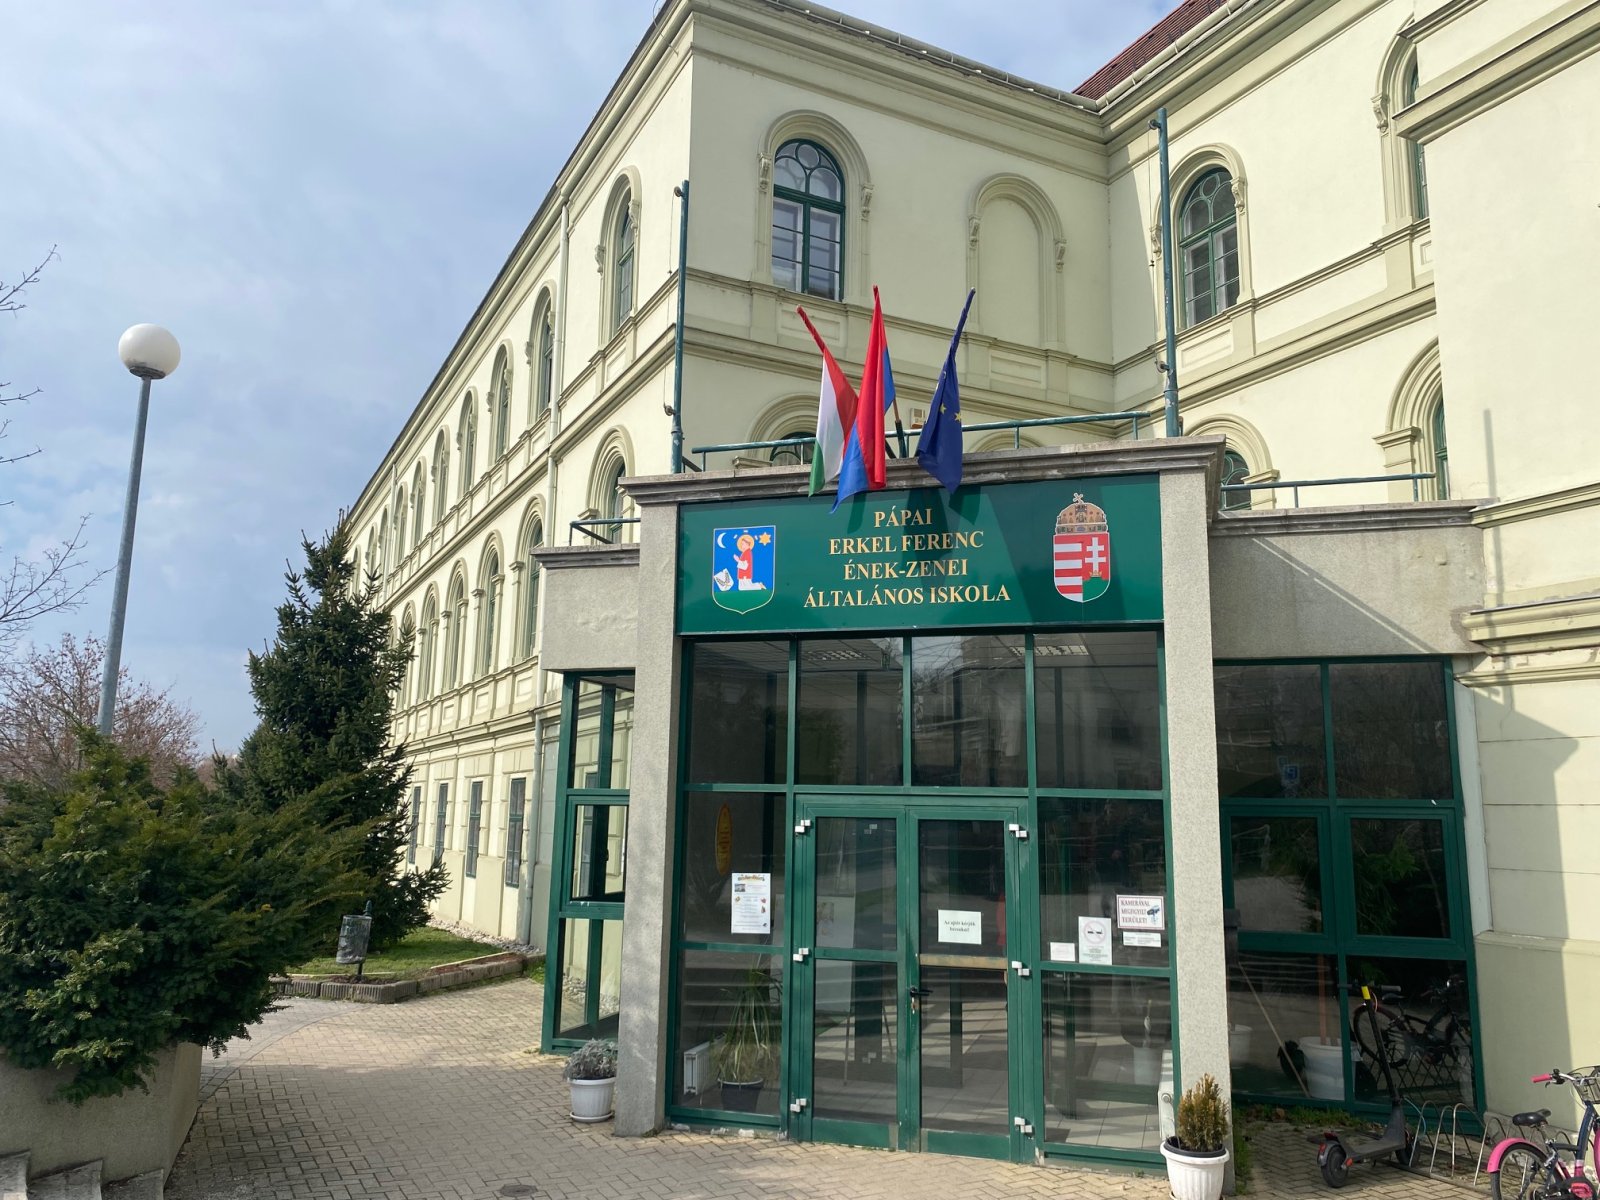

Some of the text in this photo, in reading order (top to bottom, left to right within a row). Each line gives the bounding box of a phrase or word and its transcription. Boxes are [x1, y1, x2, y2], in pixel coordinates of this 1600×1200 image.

[874, 505, 933, 528] PÁPAI
[829, 531, 985, 556] ERKEL FERENC
[843, 558, 969, 580] ÉNEK-ZENEI
[803, 584, 1012, 609] ÁLTALÁNOS ISKOLA
